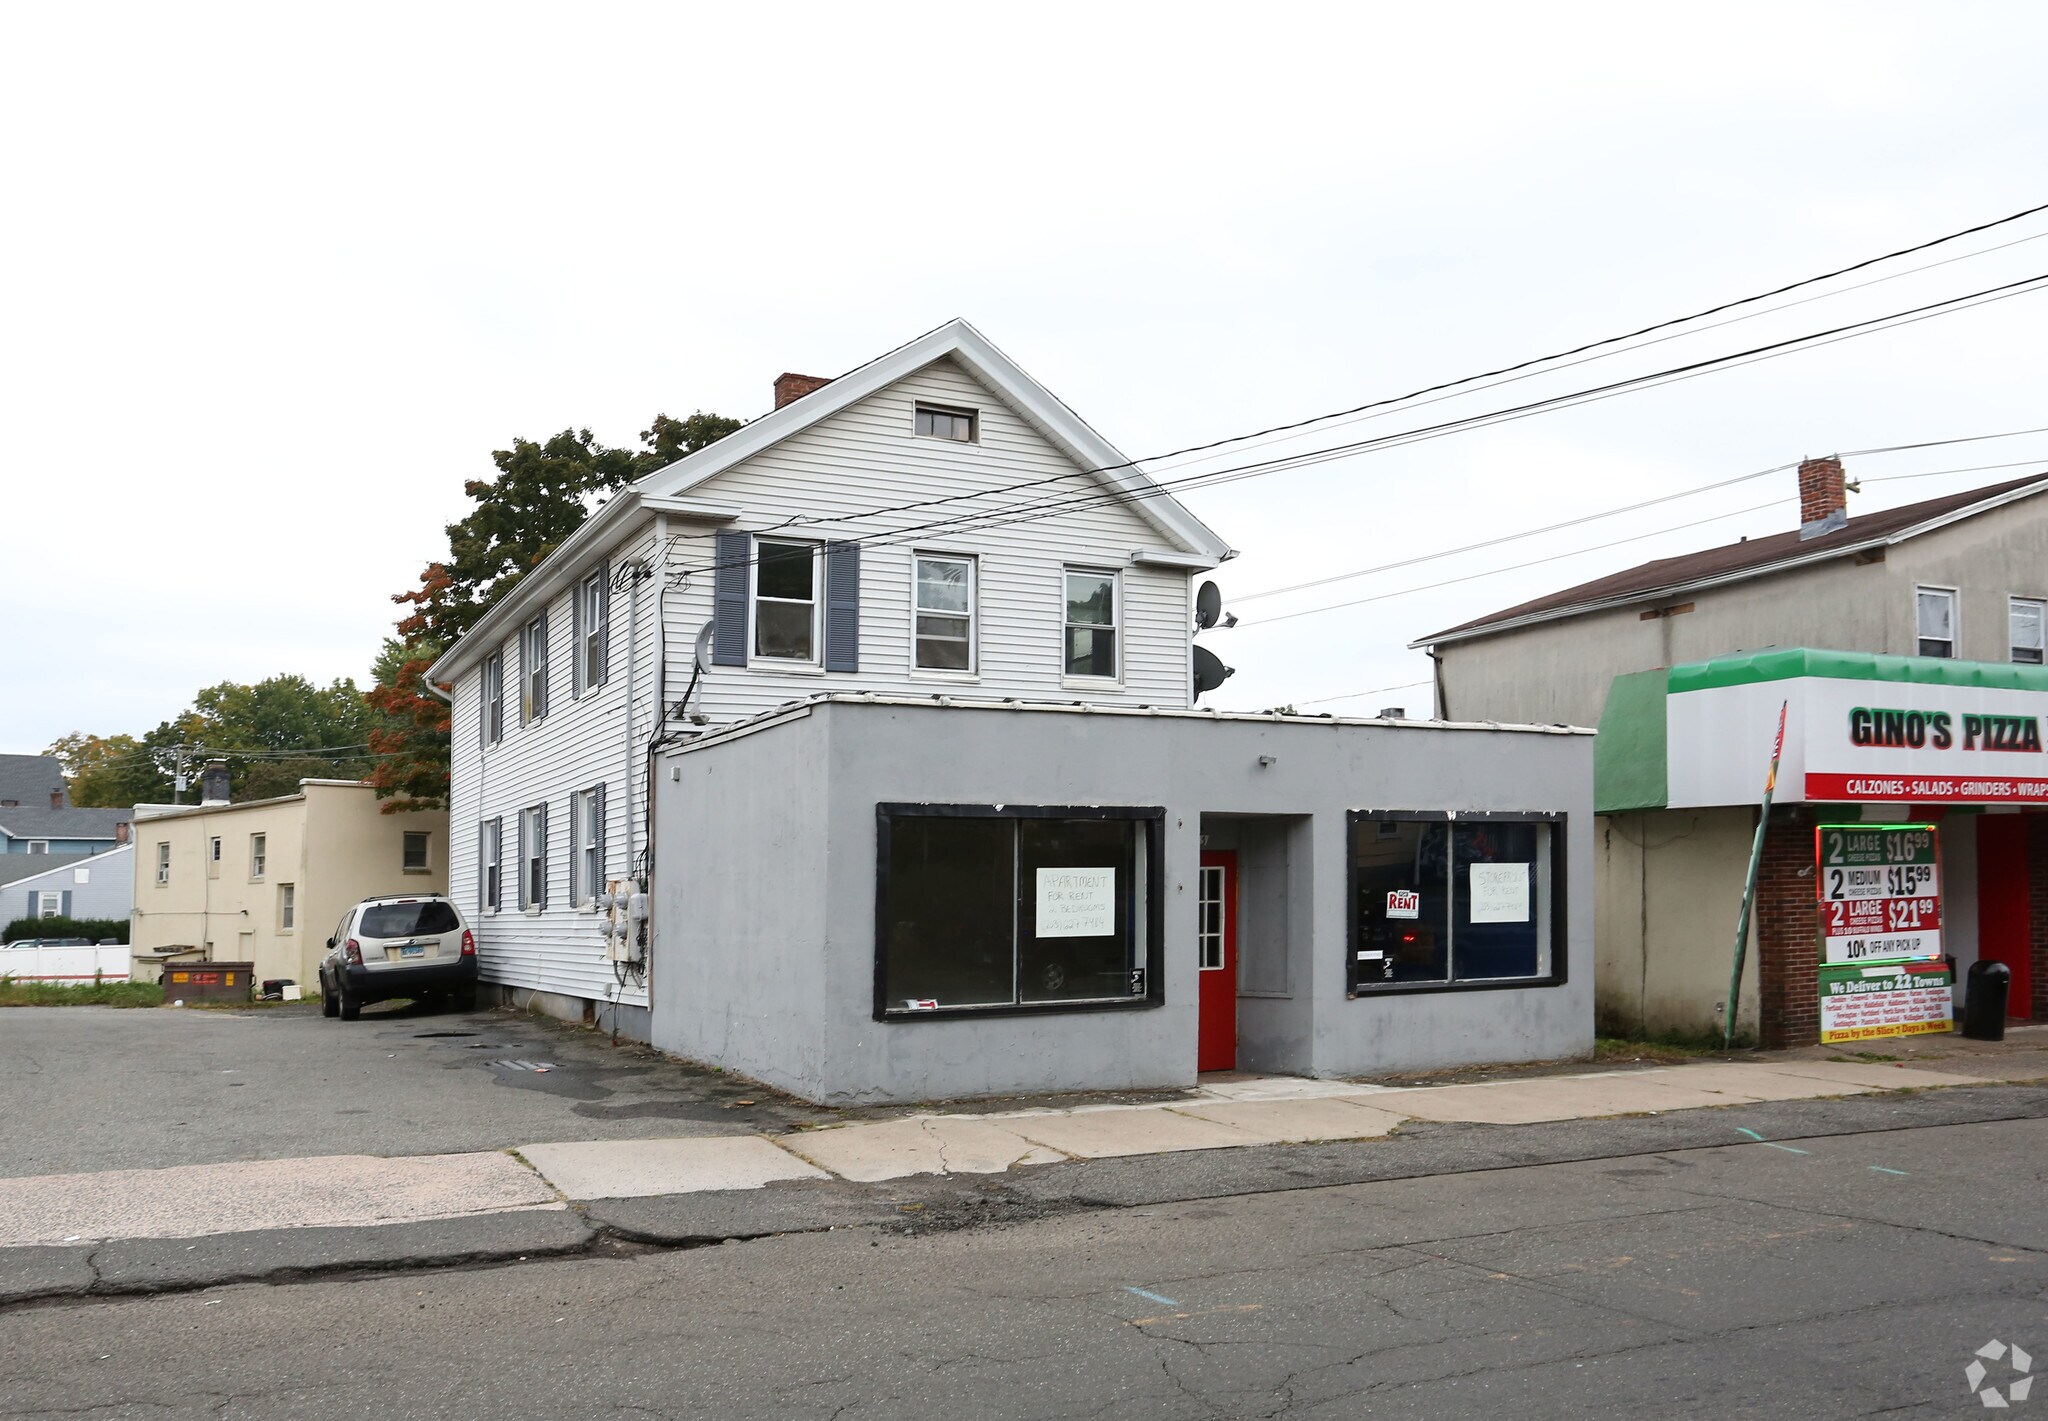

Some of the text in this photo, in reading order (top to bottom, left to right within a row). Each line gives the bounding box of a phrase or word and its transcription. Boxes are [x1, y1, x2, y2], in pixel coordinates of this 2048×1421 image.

[1849, 706, 2042, 752] GINO'S PIZZA
[1846, 780, 1904, 795] CALZONES
[1912, 780, 1952, 795] SALADS
[1960, 782, 2012, 796] GRINDERS
[1829, 832, 1844, 864] 2
[1848, 834, 1880, 851] LARGE
[1044, 874, 1108, 888] APARTMENT
[1830, 869, 1844, 900] 2
[1848, 870, 1881, 886] MEDIUM
[1048, 891, 1094, 902] FOR RENT
[1388, 894, 1418, 910] RENT
[1831, 902, 1844, 926] 2
[1850, 900, 1883, 916] LARGE
[1847, 938, 1921, 959] 10% OFF ANY PICK UP
[1830, 974, 1944, 994] We Deliver to 22 Towns
[1829, 1031, 1849, 1040] Pizza
[1851, 1030, 1860, 1039] by
[1862, 1028, 1875, 1036] the
[1877, 1026, 1894, 1035] Slice
[1902, 1024, 1920, 1033] Days
[1926, 1021, 1946, 1030] Week
